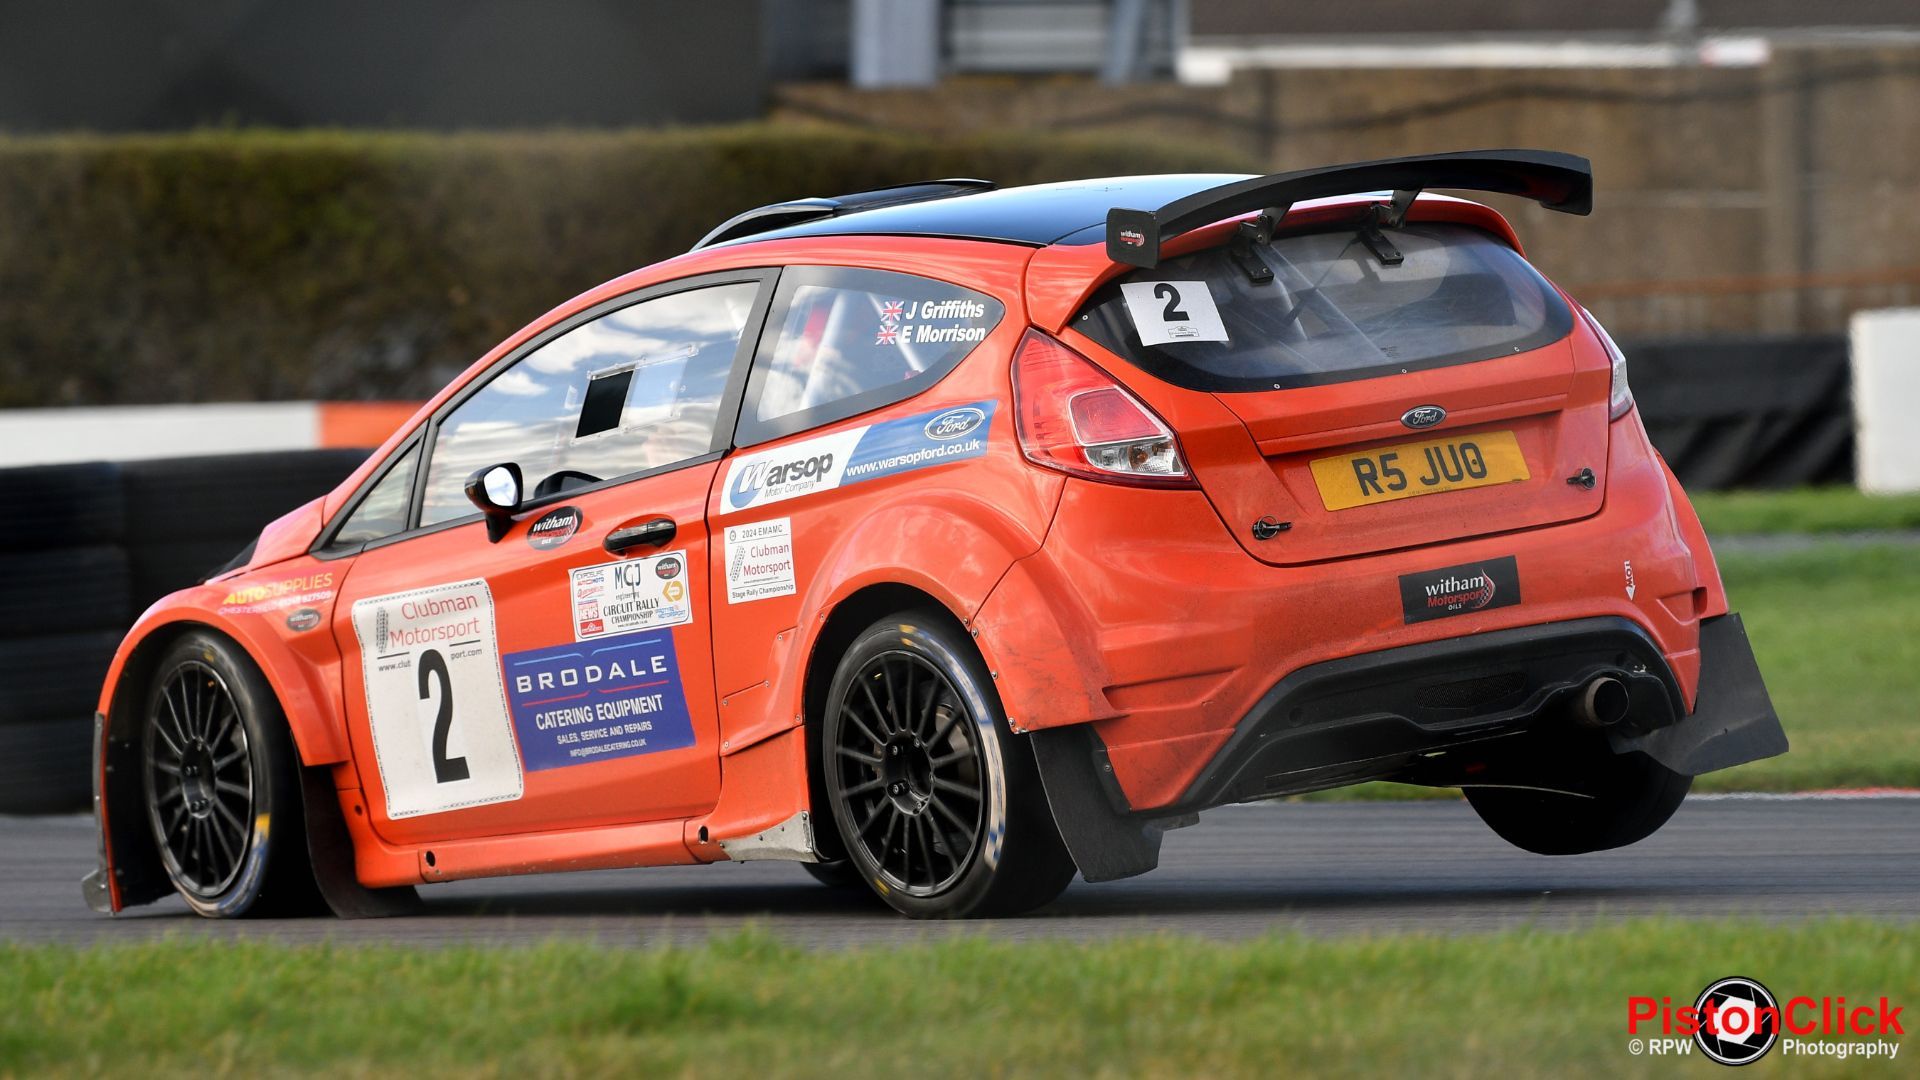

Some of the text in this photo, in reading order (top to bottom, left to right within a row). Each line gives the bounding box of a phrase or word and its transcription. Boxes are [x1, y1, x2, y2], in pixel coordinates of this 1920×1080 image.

[905, 300, 985, 320] J Griffiths
[1154, 283, 1190, 322] 2
[901, 324, 986, 344] E Morrison
[936, 414, 970, 435] Ford
[1411, 409, 1438, 425] Ford
[846, 439, 980, 478] www.warsopford.co.uk
[738, 452, 834, 494] Warsop
[1351, 452, 1408, 497] R5
[764, 479, 815, 499] Motor Company
[533, 515, 574, 532] witham
[742, 524, 783, 538] 2024 EMAMC
[750, 544, 789, 558] Clubman
[743, 560, 791, 577] Motorsport
[746, 588, 758, 597] Rally
[1425, 576, 1485, 598] witham
[401, 594, 479, 620] Clubman
[603, 601, 633, 616] CIRCUIT
[635, 597, 659, 611] RALLY
[1427, 590, 1486, 608] Motorsport
[1448, 602, 1463, 611] OILS
[611, 610, 653, 624] CHAMPIONSHIP
[390, 617, 481, 649] Motorsport
[516, 655, 667, 693] BRODALE
[418, 648, 470, 784] 2
[535, 694, 663, 730] CATERING EQUIPMENT
[557, 721, 652, 745] SALES, SERVICE AND REPAIRS
